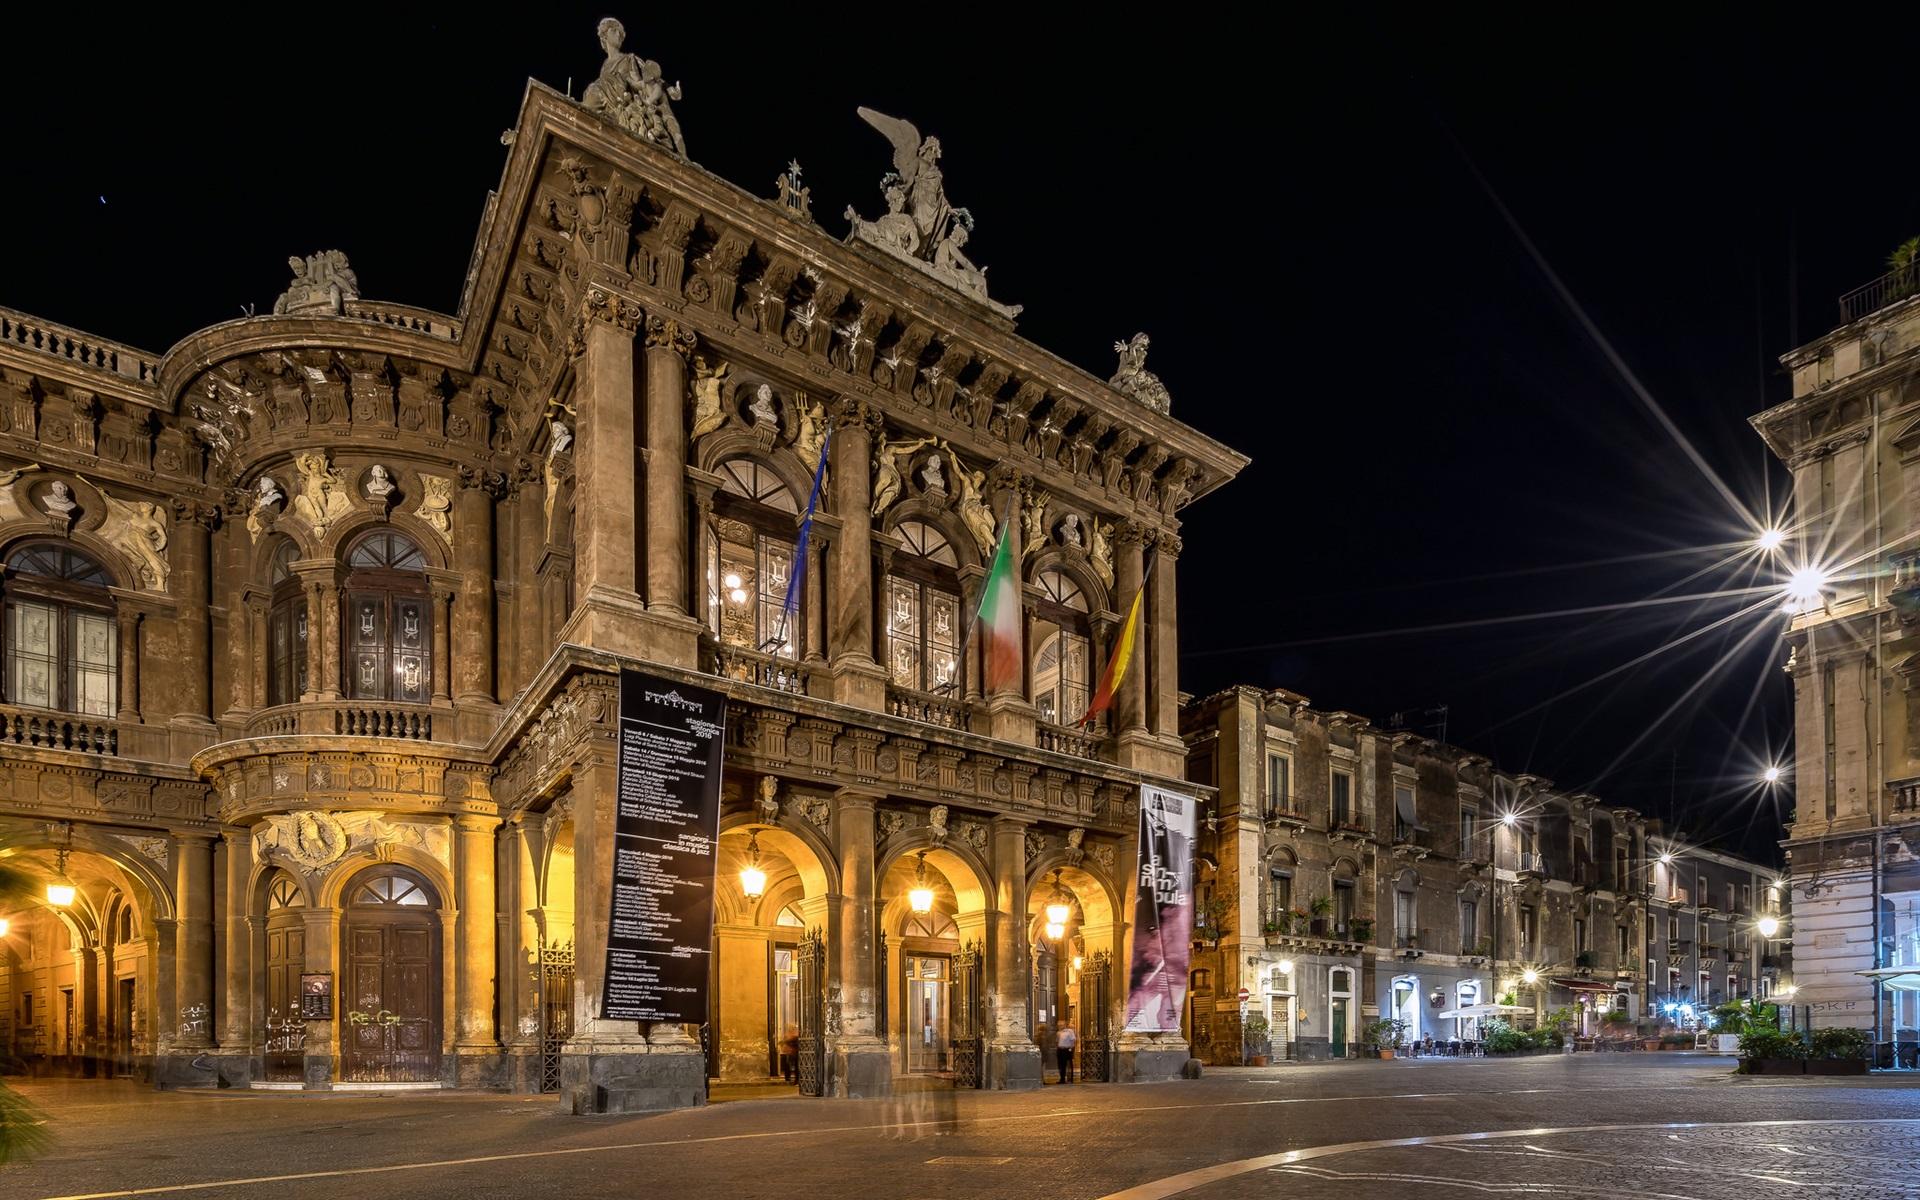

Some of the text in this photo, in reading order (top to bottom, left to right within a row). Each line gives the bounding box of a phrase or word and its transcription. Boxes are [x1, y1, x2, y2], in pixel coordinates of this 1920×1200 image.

[645, 696, 702, 713] BELLINI
[686, 716, 715, 729] stagione
[691, 725, 719, 735] sinfonica
[696, 730, 712, 739] 2016
[686, 841, 709, 850] musica
